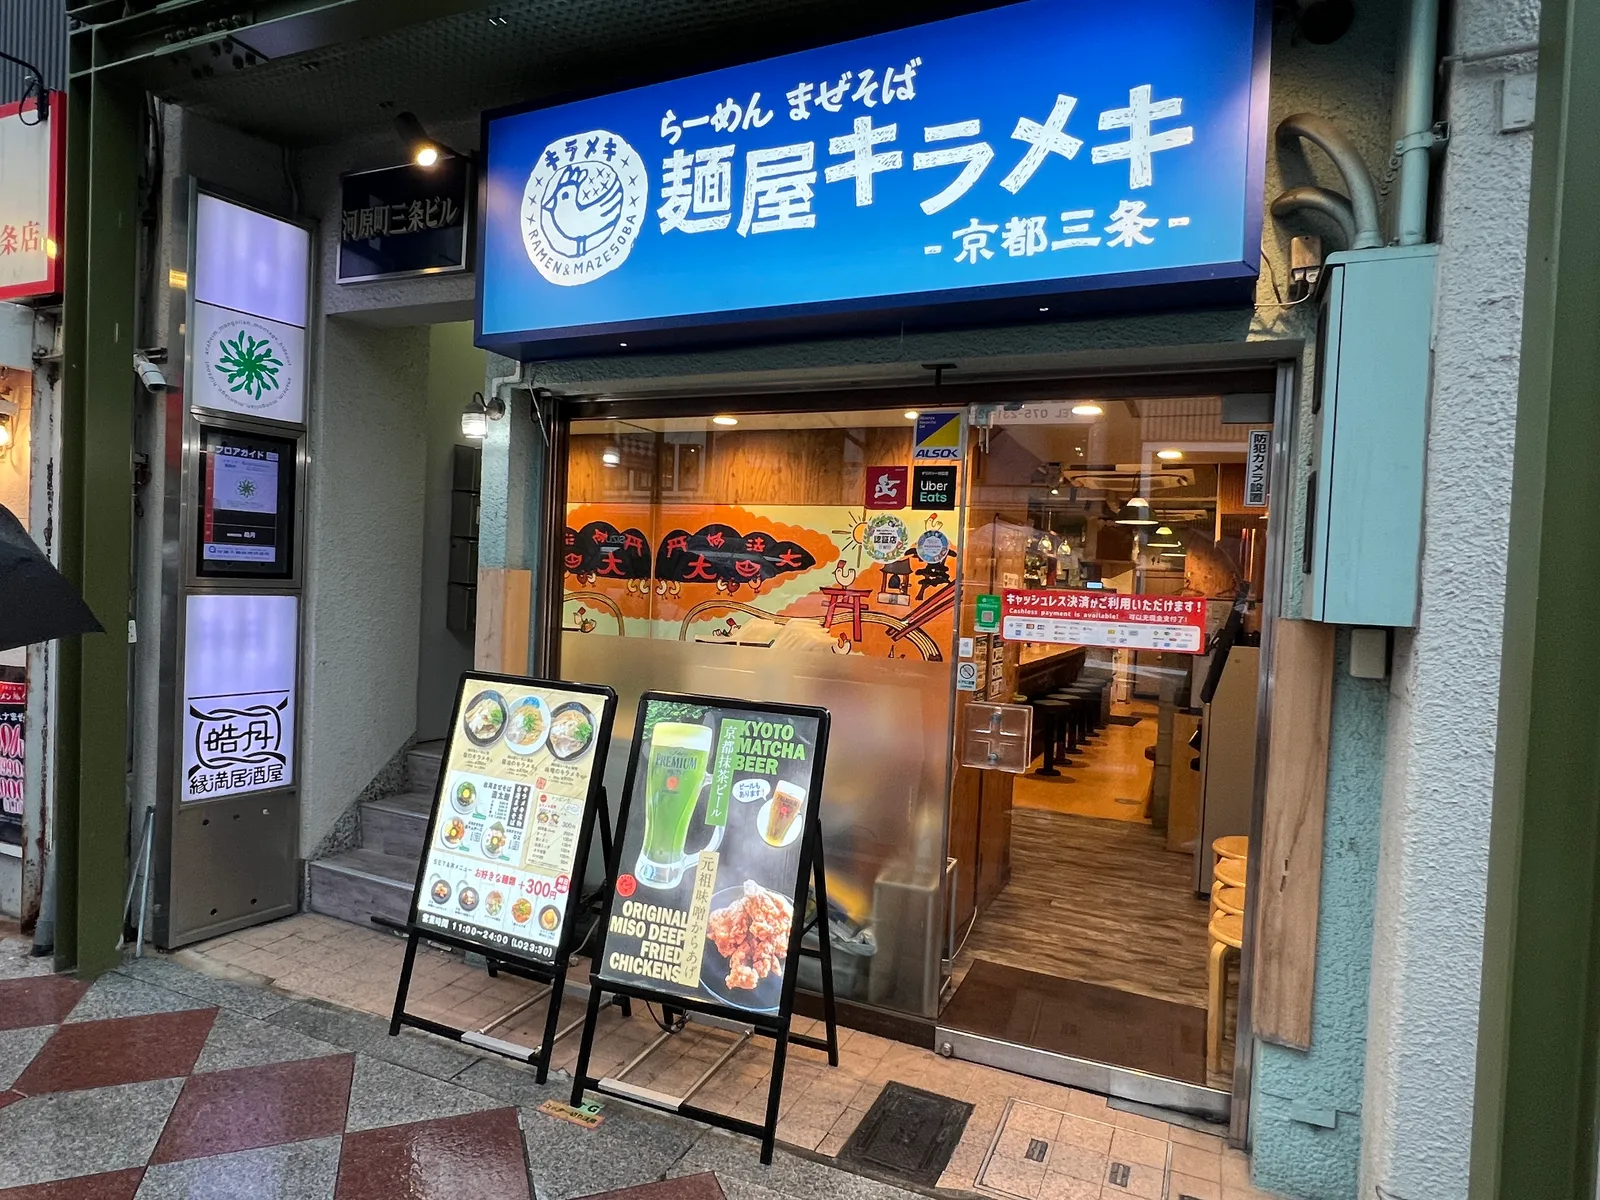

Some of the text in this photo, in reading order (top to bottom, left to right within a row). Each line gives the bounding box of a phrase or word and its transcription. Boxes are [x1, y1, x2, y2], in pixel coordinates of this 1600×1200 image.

[660, 58, 924, 144] らーめん まぜそば
[545, 136, 617, 170] キラメキ
[657, 84, 1194, 238] 麺屋キラメキ
[342, 196, 458, 241] 河原町三条ビル
[215, 445, 265, 459] フロアガイド
[915, 449, 959, 458] ALSOK
[1250, 433, 1268, 503] 防犯カメラ設置
[919, 492, 948, 503] Eats
[920, 480, 948, 491] Uber
[1005, 592, 1203, 614] キャッシュレス決済がご利用いただけます！
[1009, 607, 1119, 621] Cashless payment is available!
[203, 720, 274, 754] 皓丹
[741, 720, 794, 741] KYOTO
[655, 752, 698, 770] PREMIUM
[737, 738, 806, 761] MATCHA
[710, 723, 738, 819] 京都抹茶ビール
[736, 755, 779, 776] BEER
[189, 764, 284, 795] 縁満居酒屋
[739, 782, 761, 790] ビールも
[421, 912, 450, 929] 営業時間
[622, 899, 689, 930] ORIGINAL
[683, 854, 715, 980] 元祖味噌からあげ
[609, 914, 687, 946] MISO DEEP
[639, 939, 684, 965] FRIED
[609, 951, 682, 983] CHICKENS
